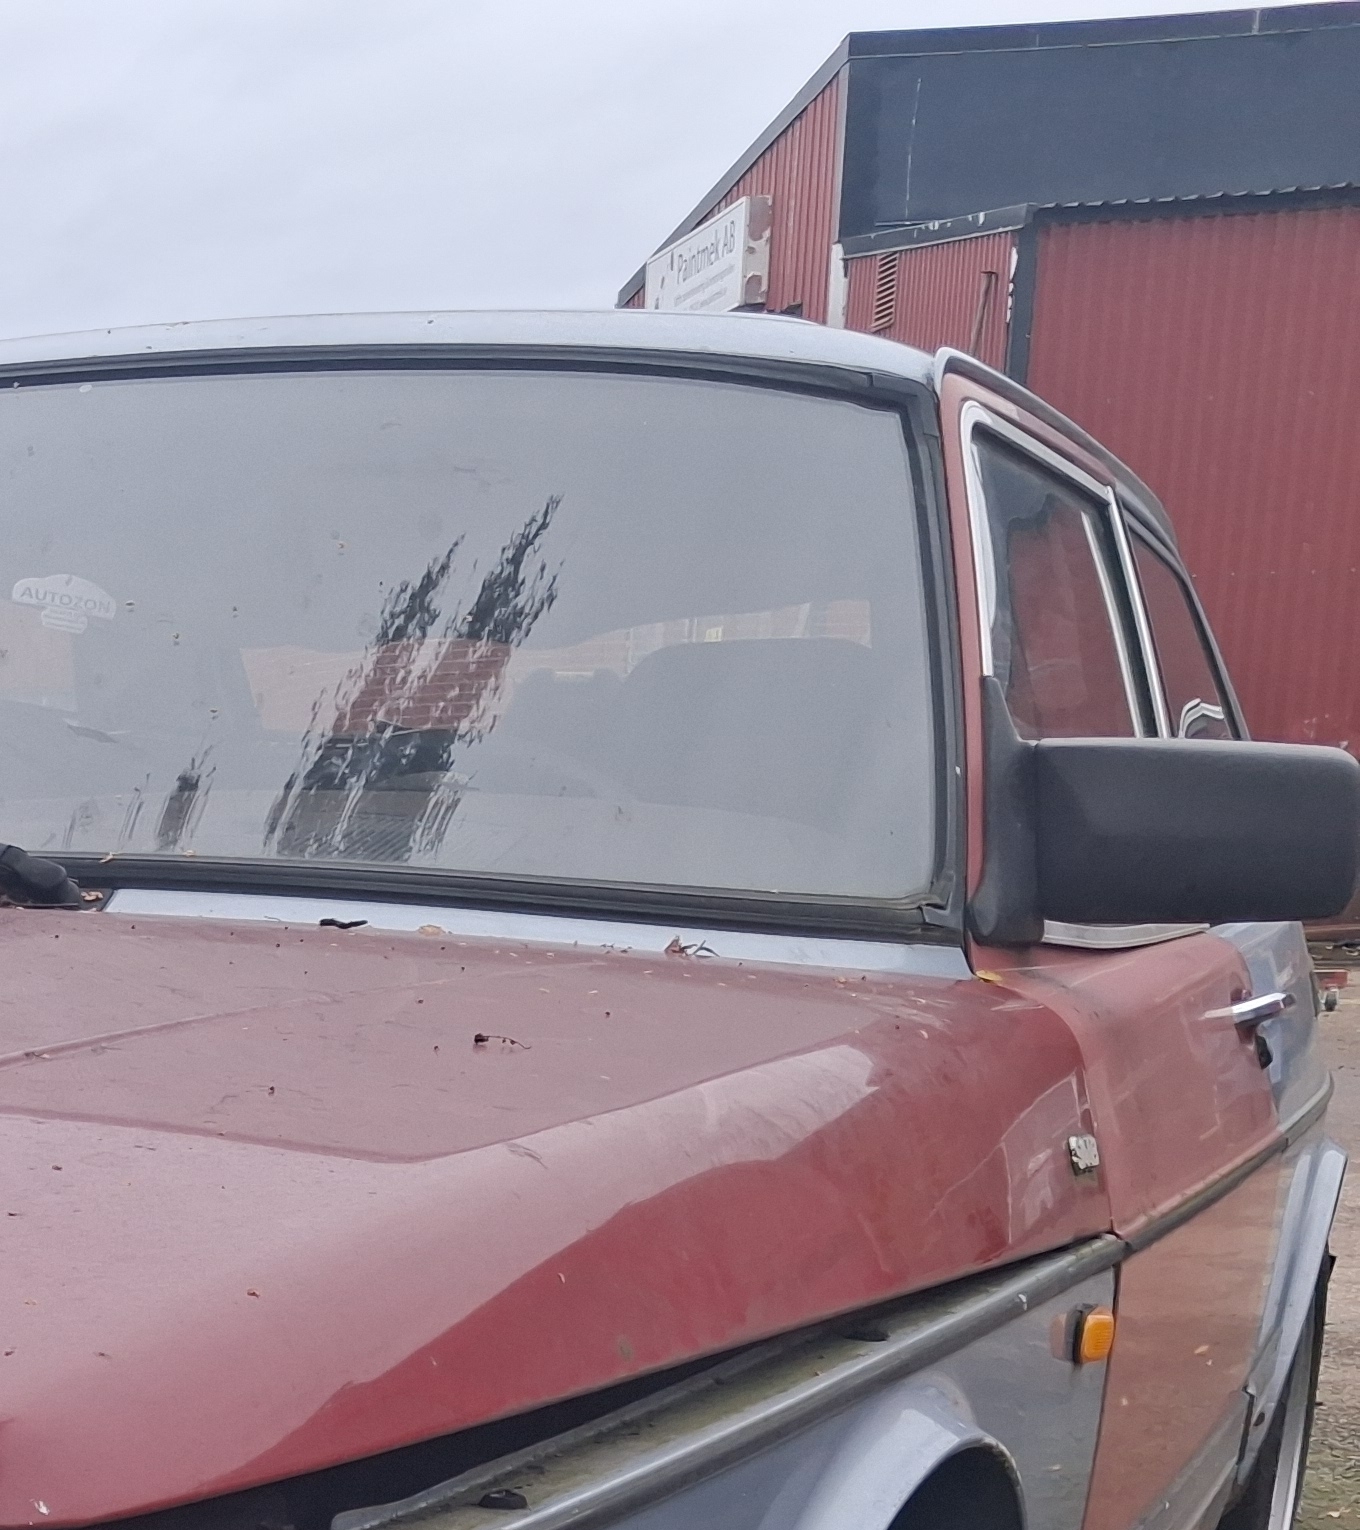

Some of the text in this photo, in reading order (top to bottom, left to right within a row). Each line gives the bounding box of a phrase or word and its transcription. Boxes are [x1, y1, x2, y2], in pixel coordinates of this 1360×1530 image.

[677, 220, 735, 284] Paintmek AB
[20, 587, 109, 613] AUTOZON
